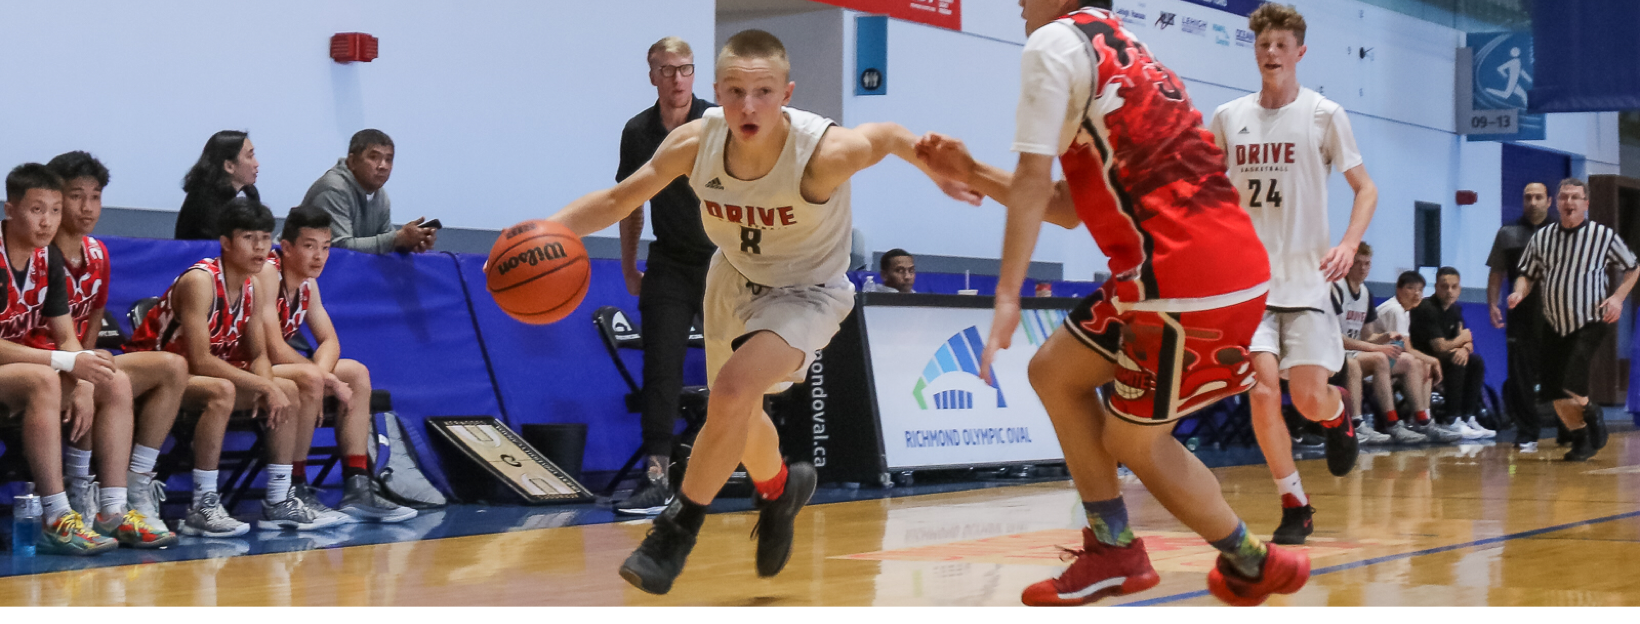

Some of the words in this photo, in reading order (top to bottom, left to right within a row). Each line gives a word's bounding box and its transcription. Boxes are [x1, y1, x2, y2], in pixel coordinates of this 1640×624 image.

[1236, 143, 1295, 166] DRIVE
[1248, 179, 1282, 207] 24
[704, 200, 798, 226] DRIVE
[740, 226, 762, 255] 8
[498, 242, 567, 275] Wilson
[904, 430, 960, 448] RICHMOND
[962, 428, 1004, 446] OLYMPIC
[1006, 427, 1032, 443] OVAL
